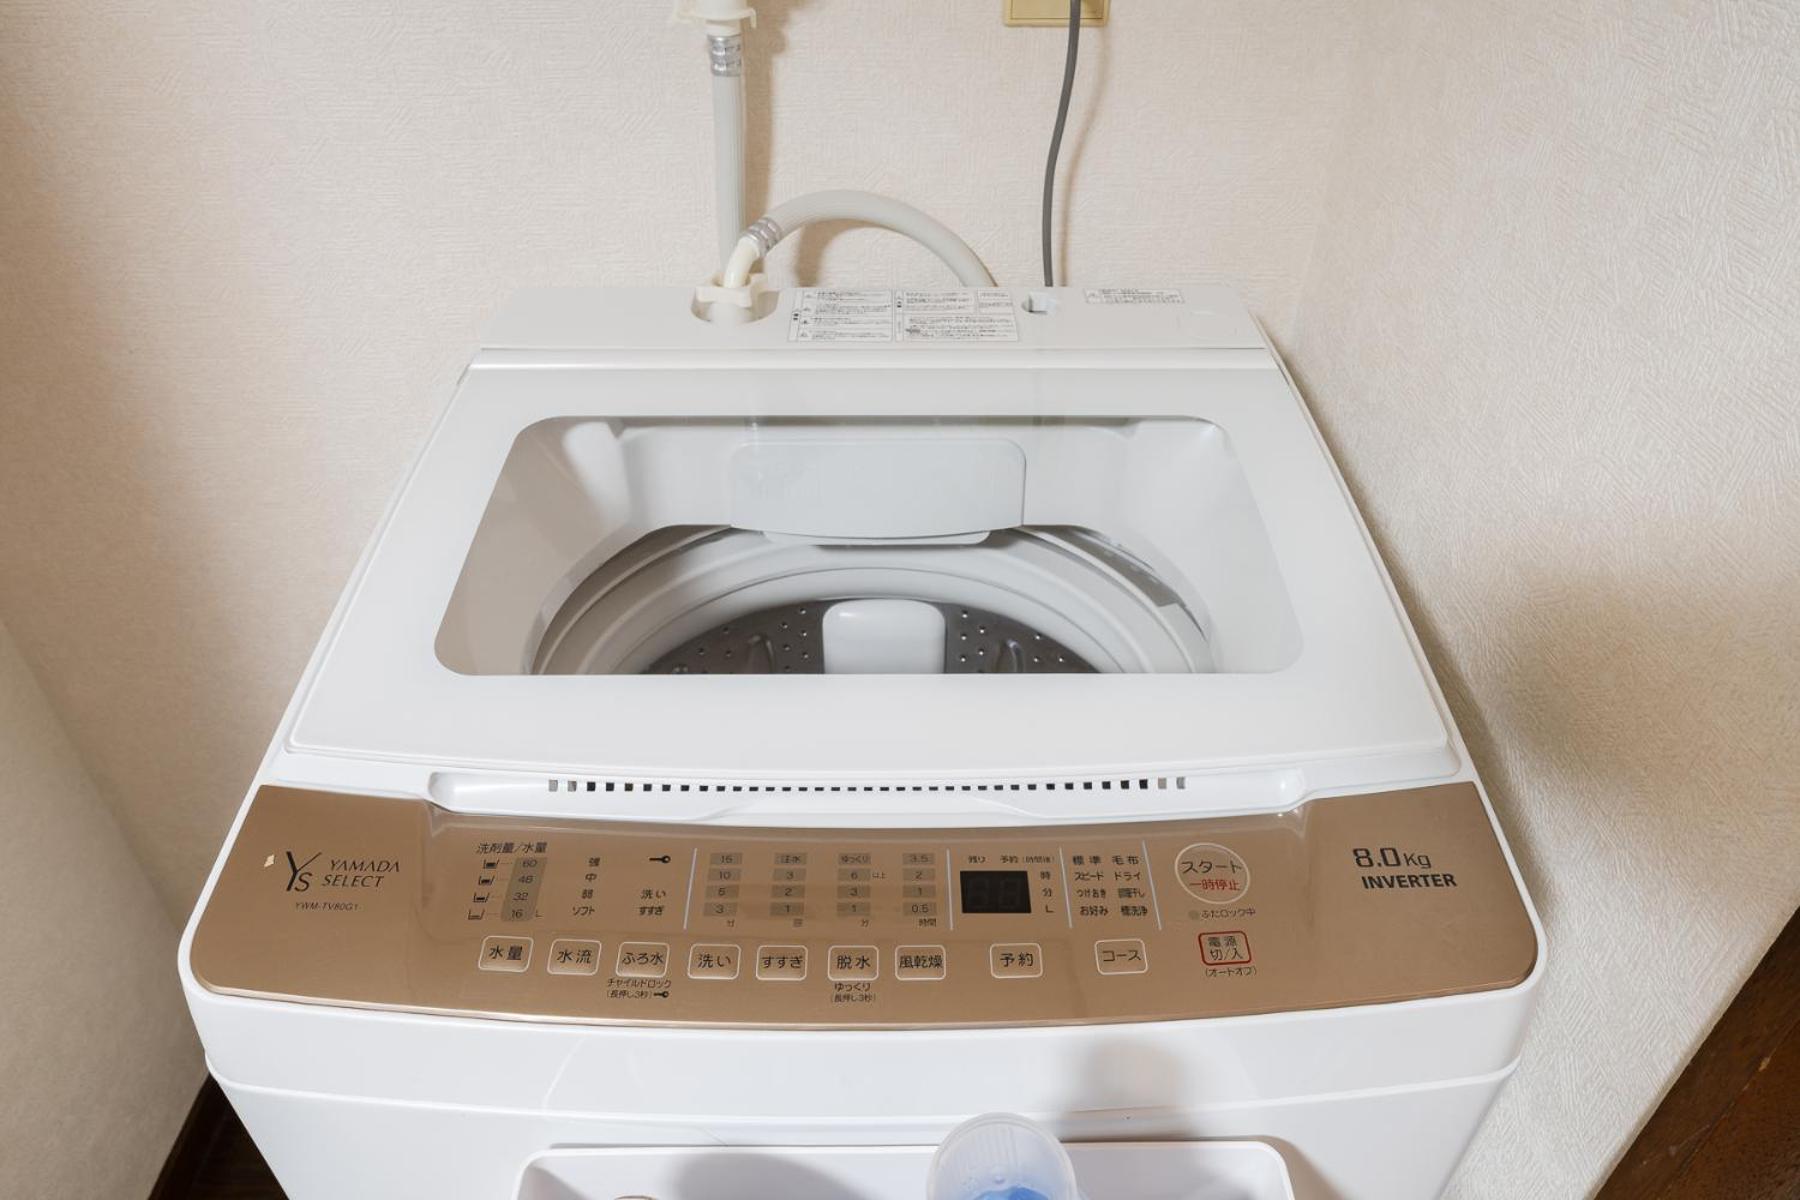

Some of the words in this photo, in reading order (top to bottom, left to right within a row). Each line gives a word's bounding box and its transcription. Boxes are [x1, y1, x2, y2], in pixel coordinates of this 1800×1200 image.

[522, 858, 538, 868] 60
[721, 855, 733, 864] 15
[840, 855, 870, 864] ゆっくり
[909, 854, 929, 863] 3.5
[1112, 855, 1140, 866] 毛布
[330, 859, 400, 873] YAMADA
[1181, 860, 1243, 875] スタート
[321, 874, 385, 888] SELECT
[585, 872, 597, 882] 中
[719, 871, 731, 880] 10
[786, 871, 794, 880] 3
[915, 871, 923, 880] 2
[1075, 870, 1105, 881] スピード
[1114, 870, 1142, 881] ドライ
[1361, 873, 1458, 889] INVERTER
[1189, 878, 1241, 892] 一時停止
[513, 892, 529, 901] 32
[641, 889, 667, 900] 洗い
[784, 887, 793, 896] 2
[850, 887, 858, 896] 3
[511, 908, 525, 919] 16
[535, 909, 544, 918] L
[572, 905, 596, 916] ソフト
[638, 906, 664, 916] すすぎ
[715, 904, 724, 913] 3
[911, 904, 929, 914] 0.5
[1080, 905, 1109, 917] お好み
[1201, 907, 1257, 919] ふたロック中
[1207, 935, 1239, 948] 電源
[488, 945, 523, 961] 水量
[556, 949, 593, 965] 水流
[1103, 949, 1143, 963] コース
[1210, 948, 1244, 961] 切/入
[621, 952, 665, 966] ふろ水
[697, 953, 732, 969] 洗い
[760, 955, 804, 969] すすぎ
[836, 955, 872, 970] 脱水
[898, 954, 943, 970] 風乾燥
[1000, 953, 1034, 968] 予約
[607, 979, 672, 989] チャイルドロック
[834, 982, 871, 992] ゆっくり
